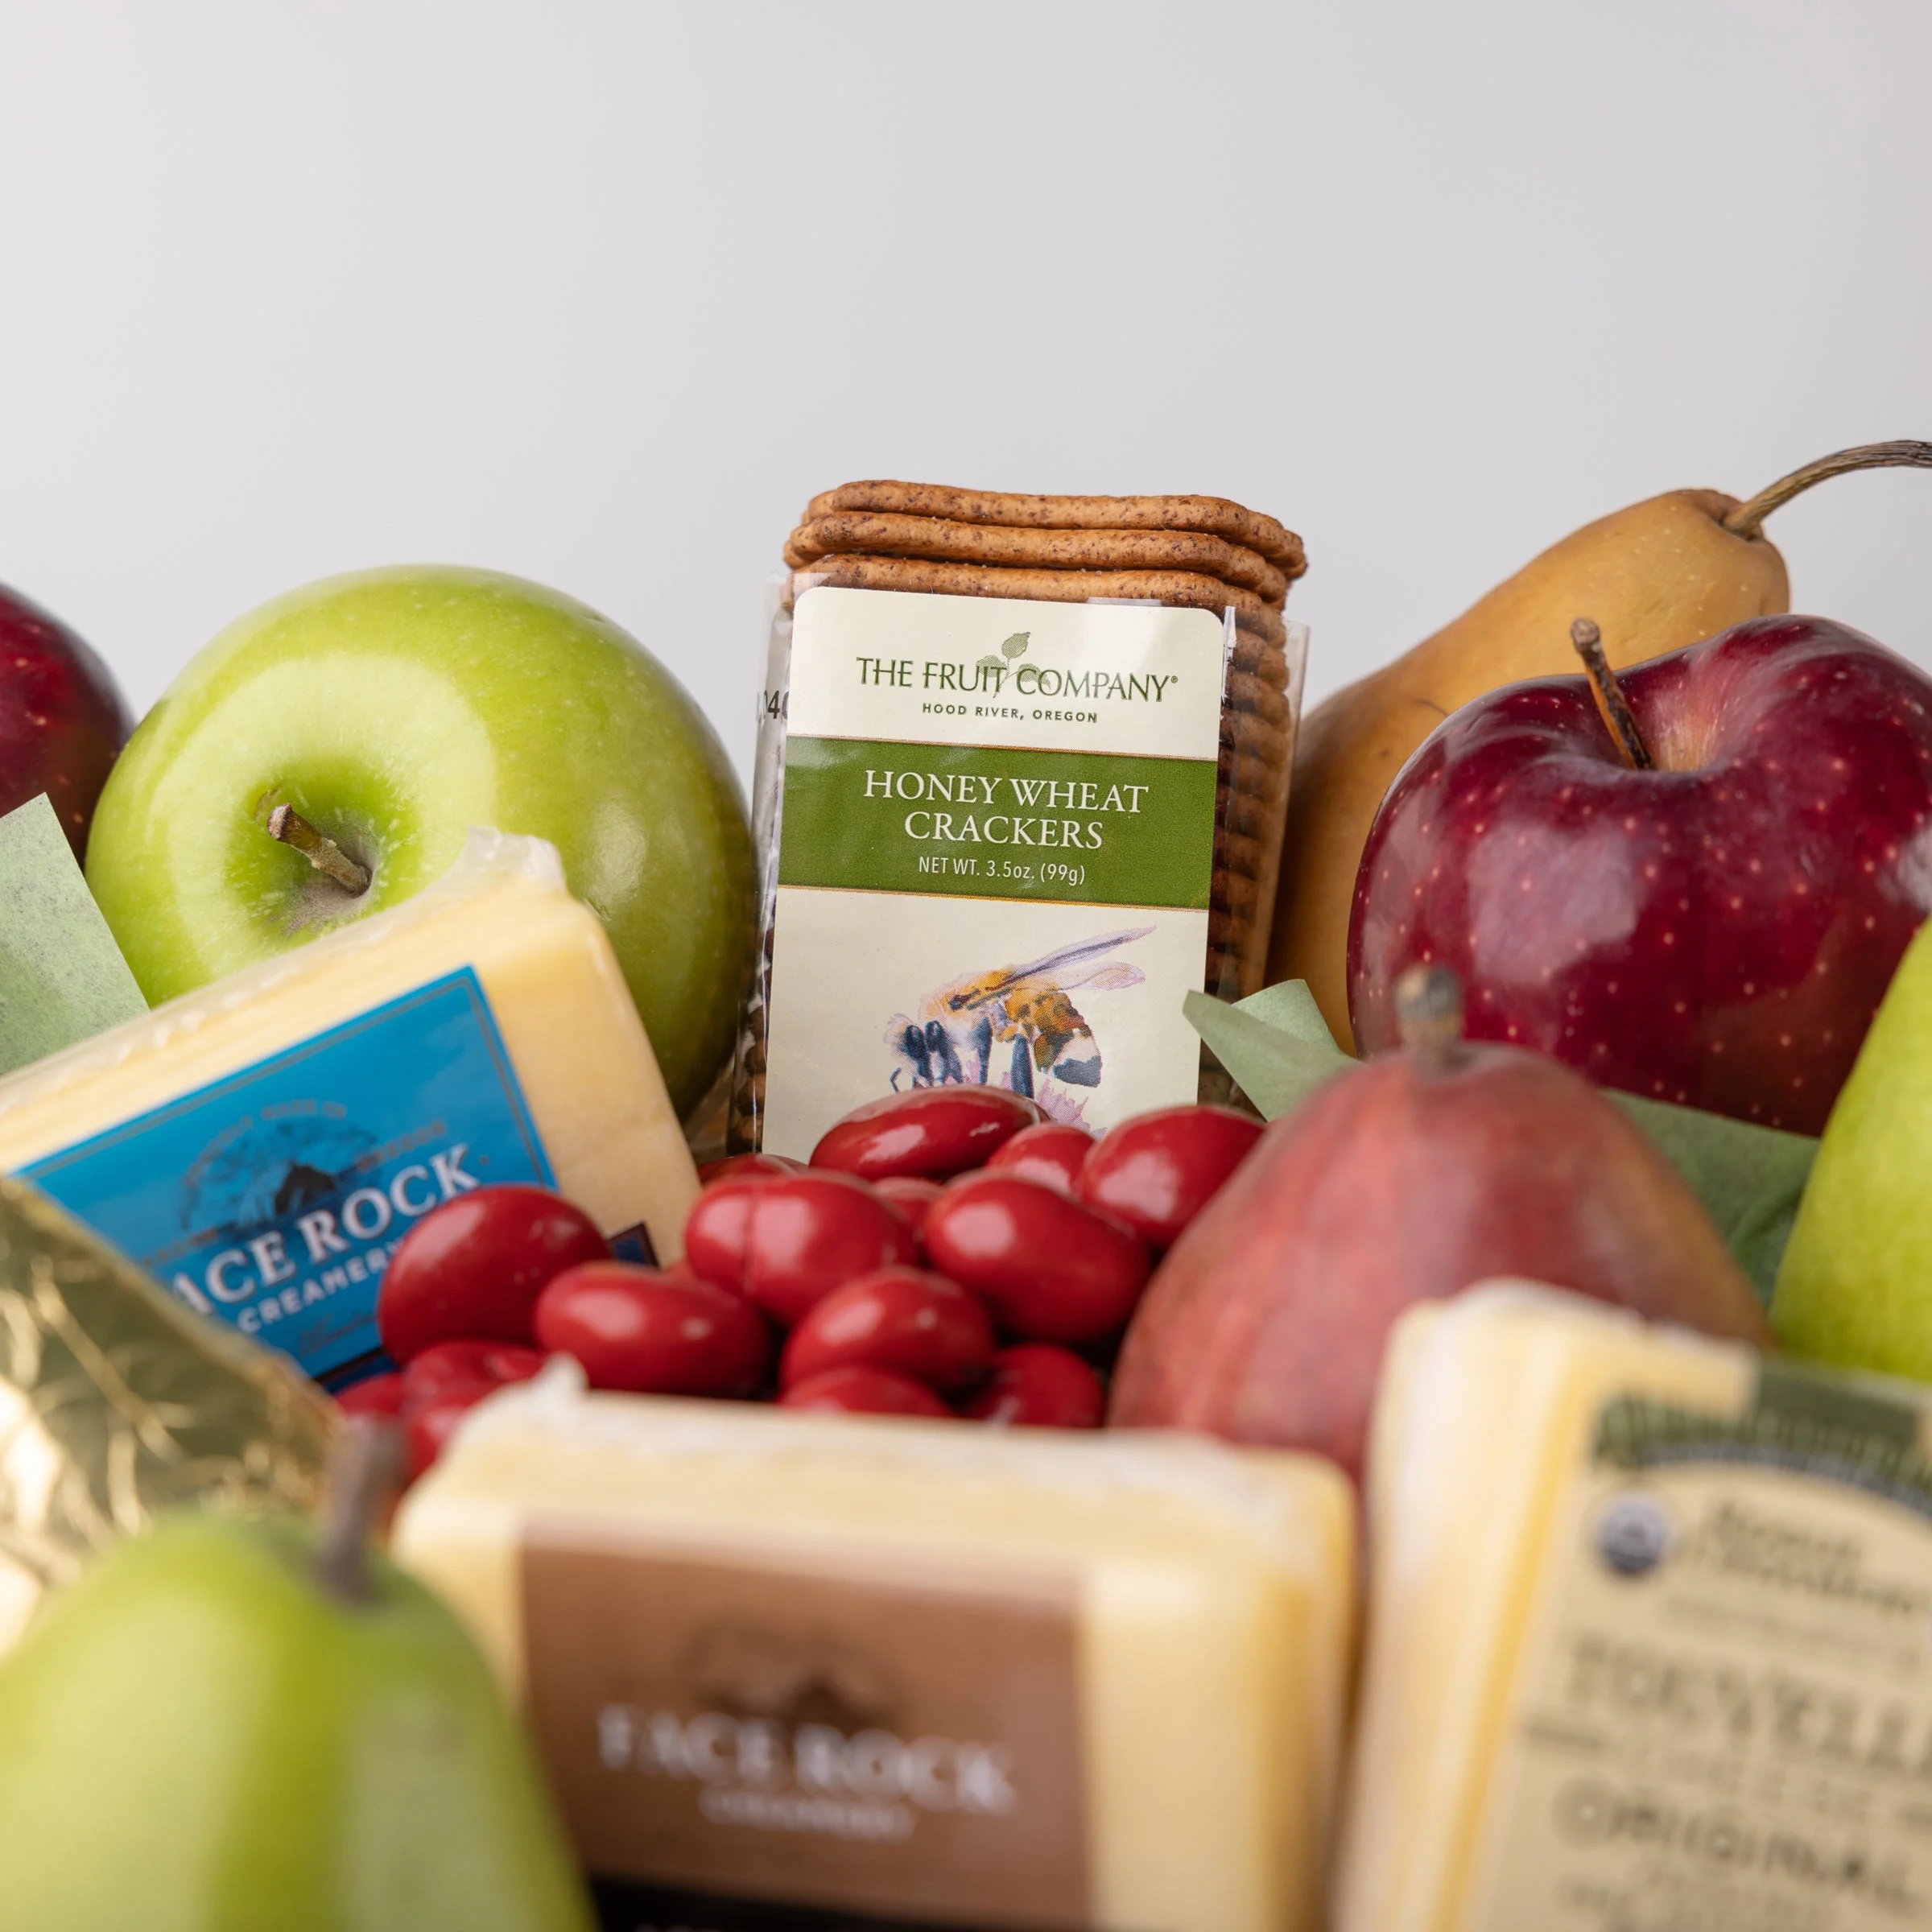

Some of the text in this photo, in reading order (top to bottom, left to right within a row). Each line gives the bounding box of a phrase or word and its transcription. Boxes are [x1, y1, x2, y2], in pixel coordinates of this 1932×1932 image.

[856, 657, 913, 687] THE
[923, 662, 1008, 693] FRUIT
[923, 703, 1098, 724] HOOD RIVER, OREGON
[864, 770, 1150, 813] HONEY WHEAT
[905, 811, 1103, 849] CRACKERS
[919, 856, 1086, 886] NET WT. 3.5oz. (99g)
[172, 1231, 296, 1315] ACE
[297, 1142, 481, 1265] ROCK
